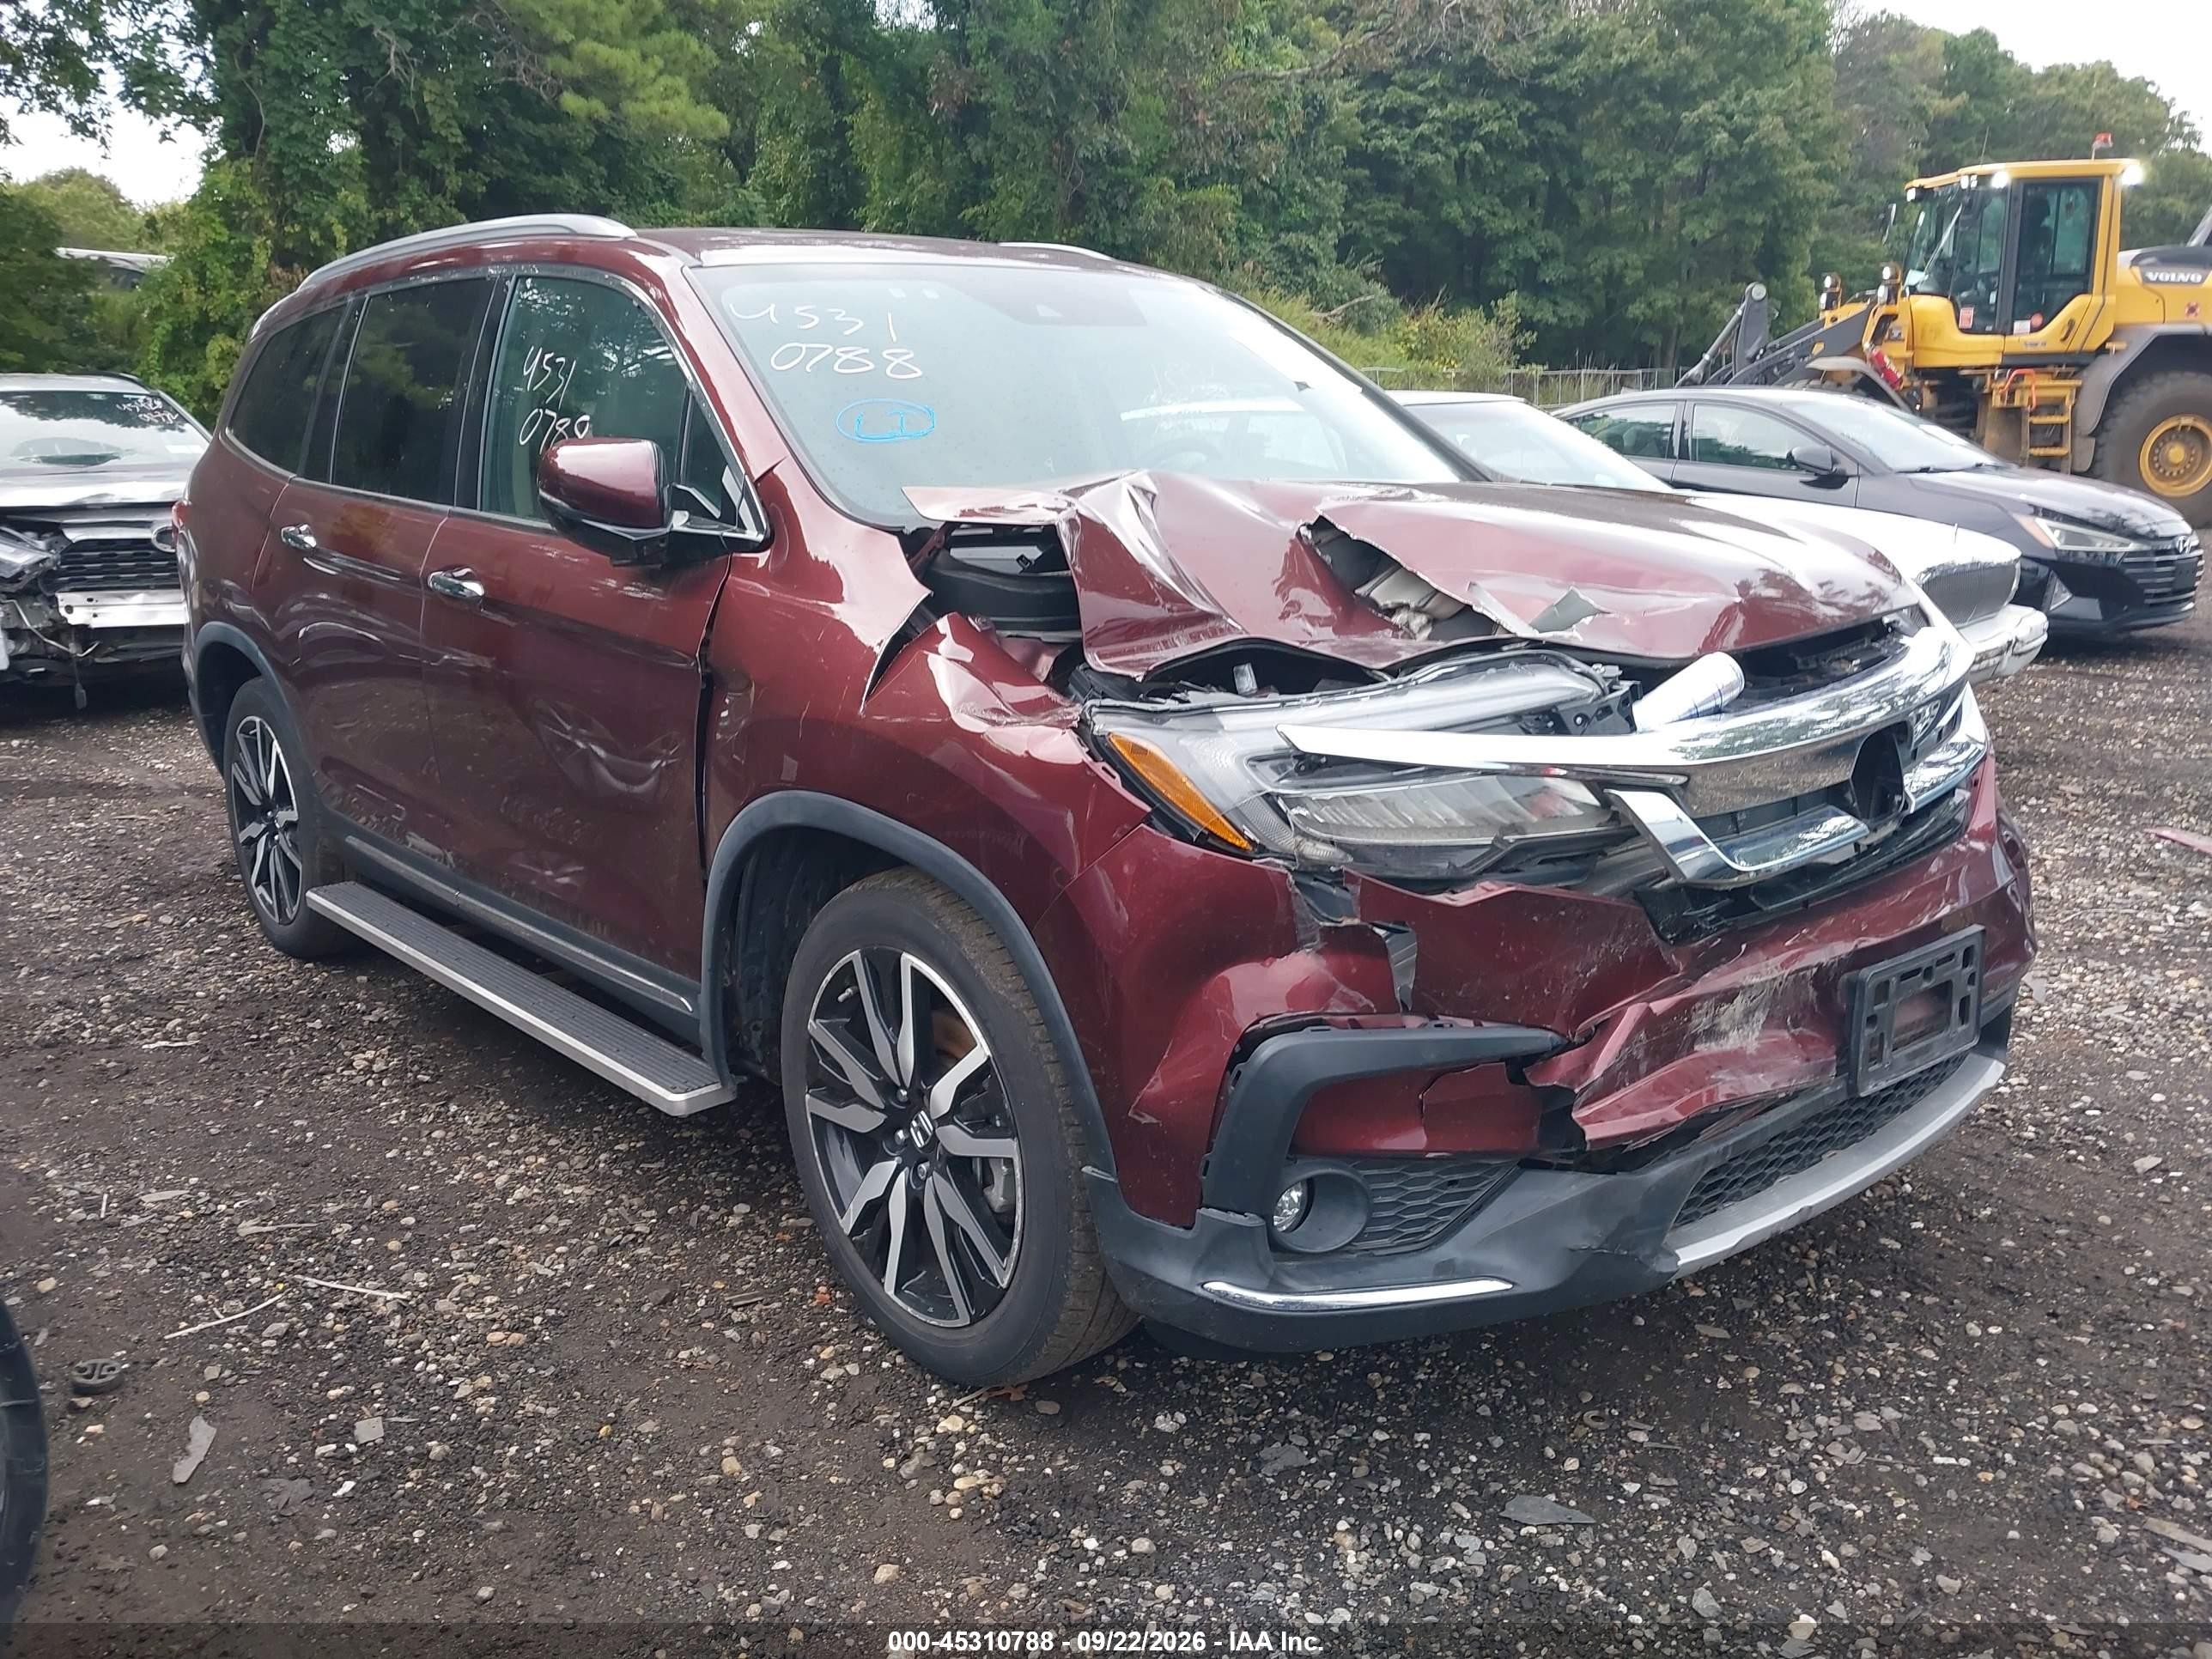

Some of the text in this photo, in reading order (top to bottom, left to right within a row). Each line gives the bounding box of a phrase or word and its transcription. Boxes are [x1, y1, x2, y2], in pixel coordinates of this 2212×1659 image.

[2146, 271, 2203, 283] VOLVO
[523, 345, 576, 410] 4531
[770, 342, 923, 379] 0788
